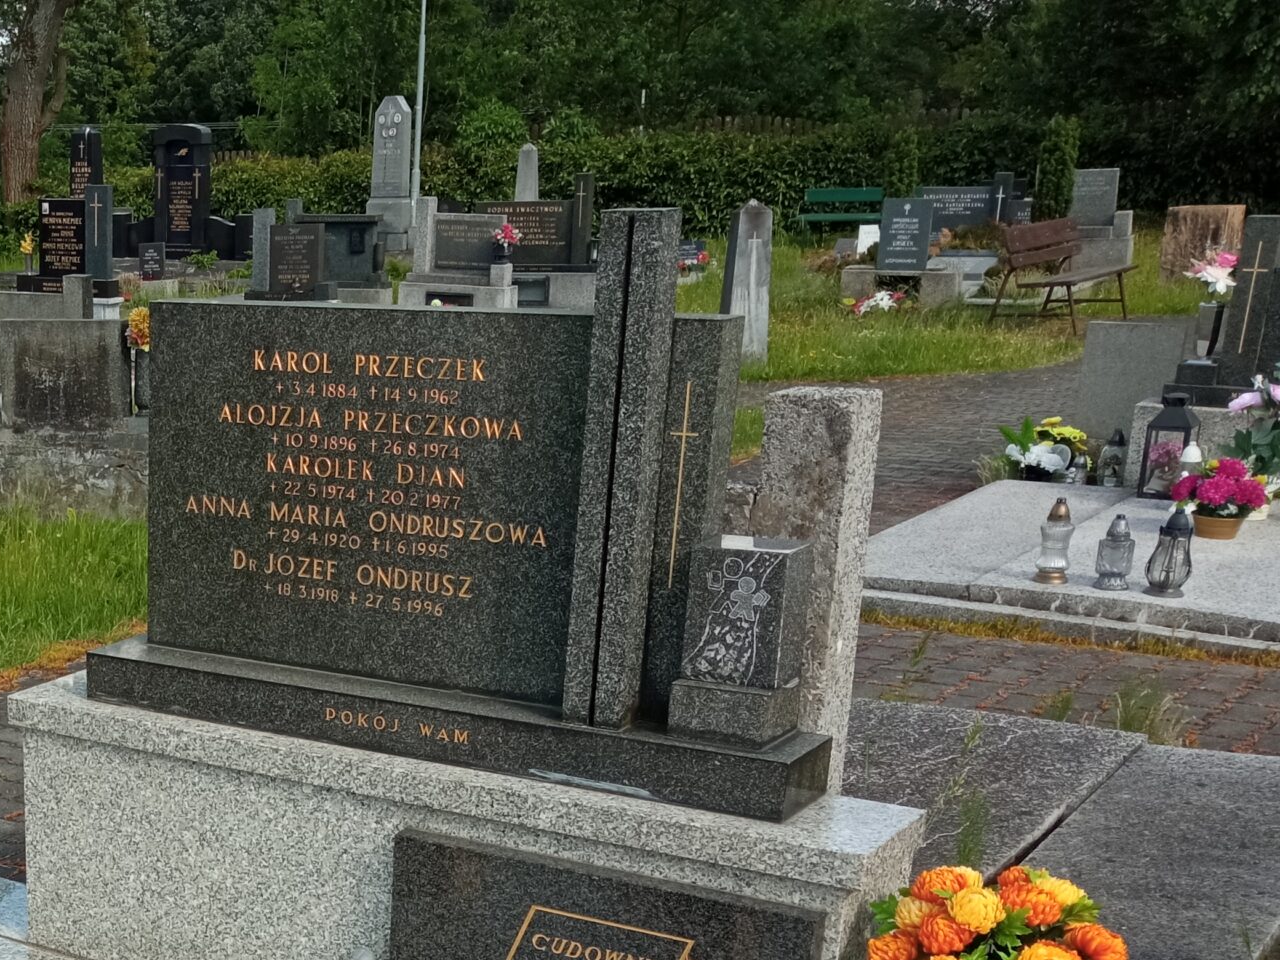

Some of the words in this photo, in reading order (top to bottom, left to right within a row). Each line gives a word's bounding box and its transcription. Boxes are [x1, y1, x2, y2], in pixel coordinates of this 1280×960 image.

[254, 350, 332, 374] KAROL
[355, 354, 486, 381] PRZECZEK
[219, 403, 322, 428] ALOJZJA
[344, 409, 522, 440] PRZECZKOWA
[266, 453, 374, 481] KAROLEK
[185, 495, 251, 519] ANNA
[270, 501, 348, 528] MARIA
[369, 511, 546, 547] ONDRUSZOWA
[264, 547, 337, 581] JÓZEF
[357, 564, 473, 598] ONDRUSZ
[325, 707, 399, 733] POKÓJ
[419, 723, 470, 744] WAM
